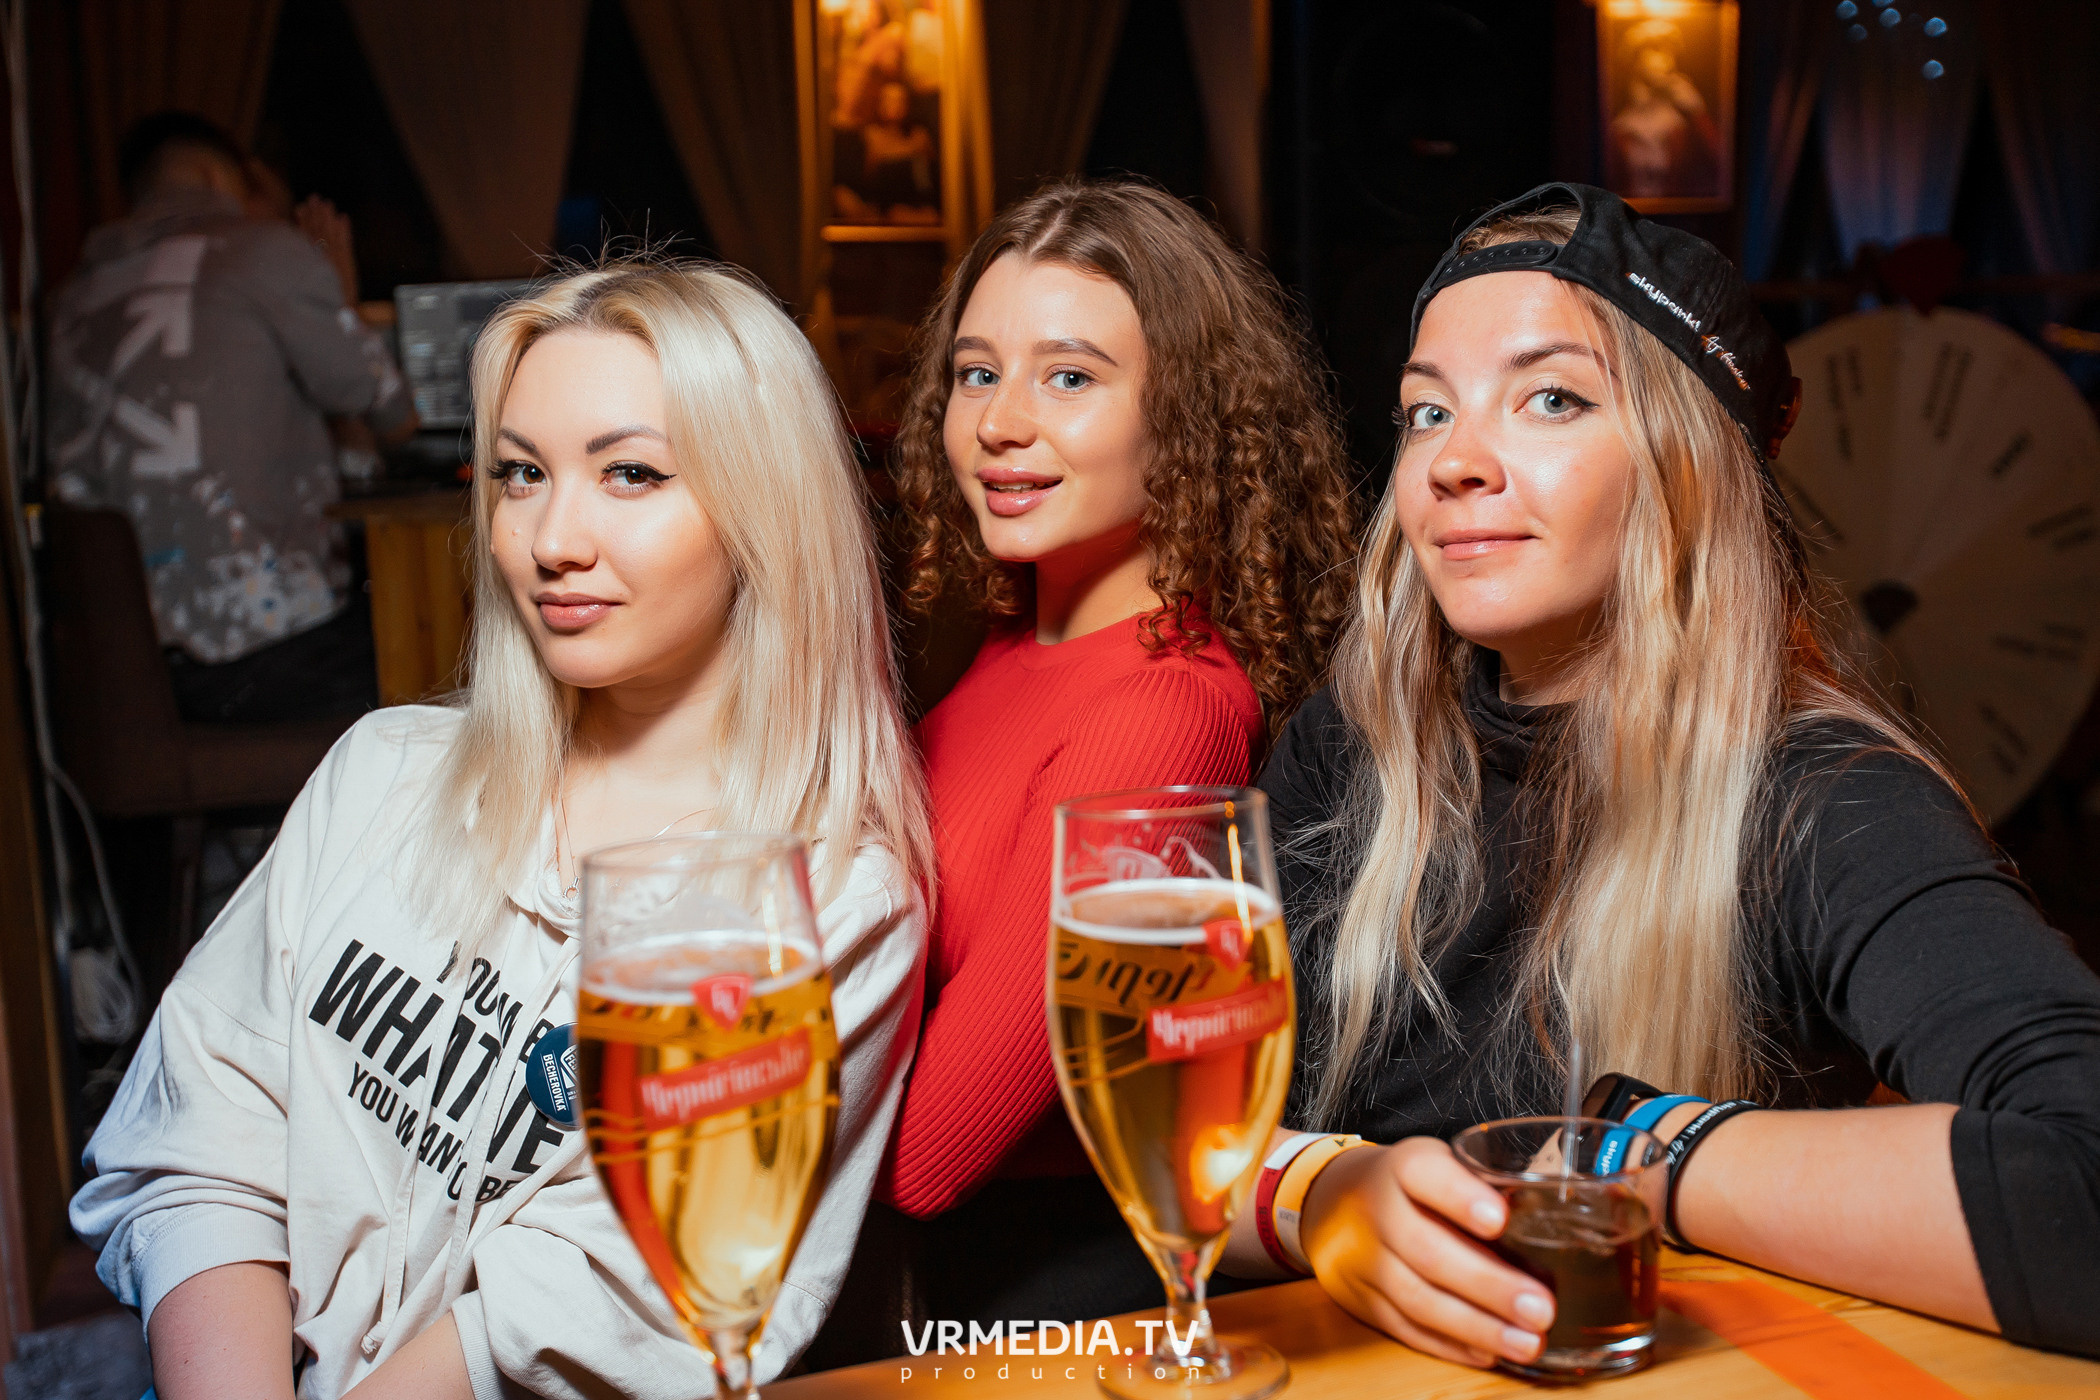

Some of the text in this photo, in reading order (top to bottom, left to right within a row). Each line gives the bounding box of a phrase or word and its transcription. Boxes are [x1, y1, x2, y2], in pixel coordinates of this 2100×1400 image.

[347, 1061, 400, 1123] YOU
[395, 1102, 466, 1174] WAN
[542, 1053, 567, 1112] BECHEROVKA
